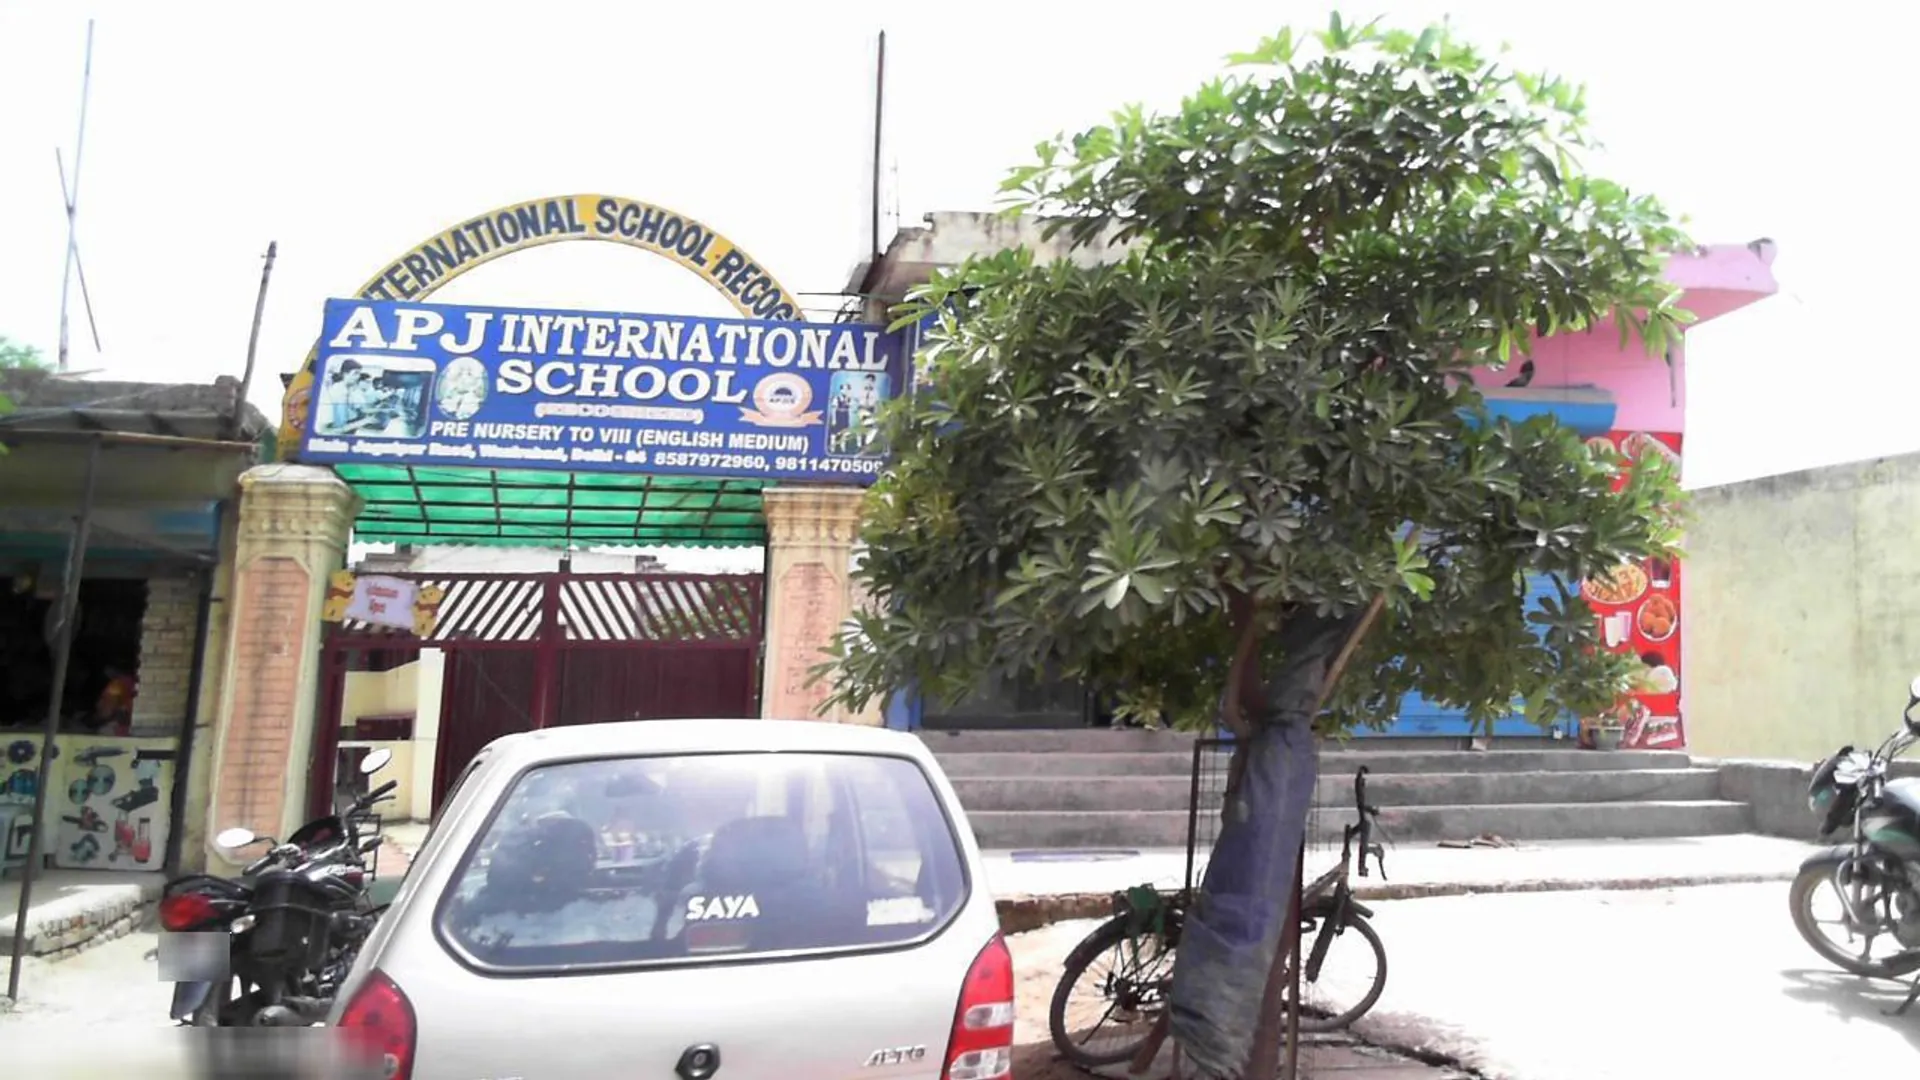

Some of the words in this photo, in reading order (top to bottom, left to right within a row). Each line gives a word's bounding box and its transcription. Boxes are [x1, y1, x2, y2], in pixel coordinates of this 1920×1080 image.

[361, 199, 585, 301] TERNATIONAL
[594, 198, 714, 267] SCHOOL
[710, 248, 798, 321] RECOG
[498, 314, 889, 371] INTERNATIONAL
[496, 358, 748, 404] SCHOOL
[430, 421, 469, 438] PRE
[474, 422, 565, 441] NURSERY
[569, 426, 594, 443] TO
[600, 429, 631, 446] VIII
[636, 429, 723, 450] (ENGLISH
[728, 433, 809, 455] MEDIUM)
[686, 894, 760, 920] SAYA
